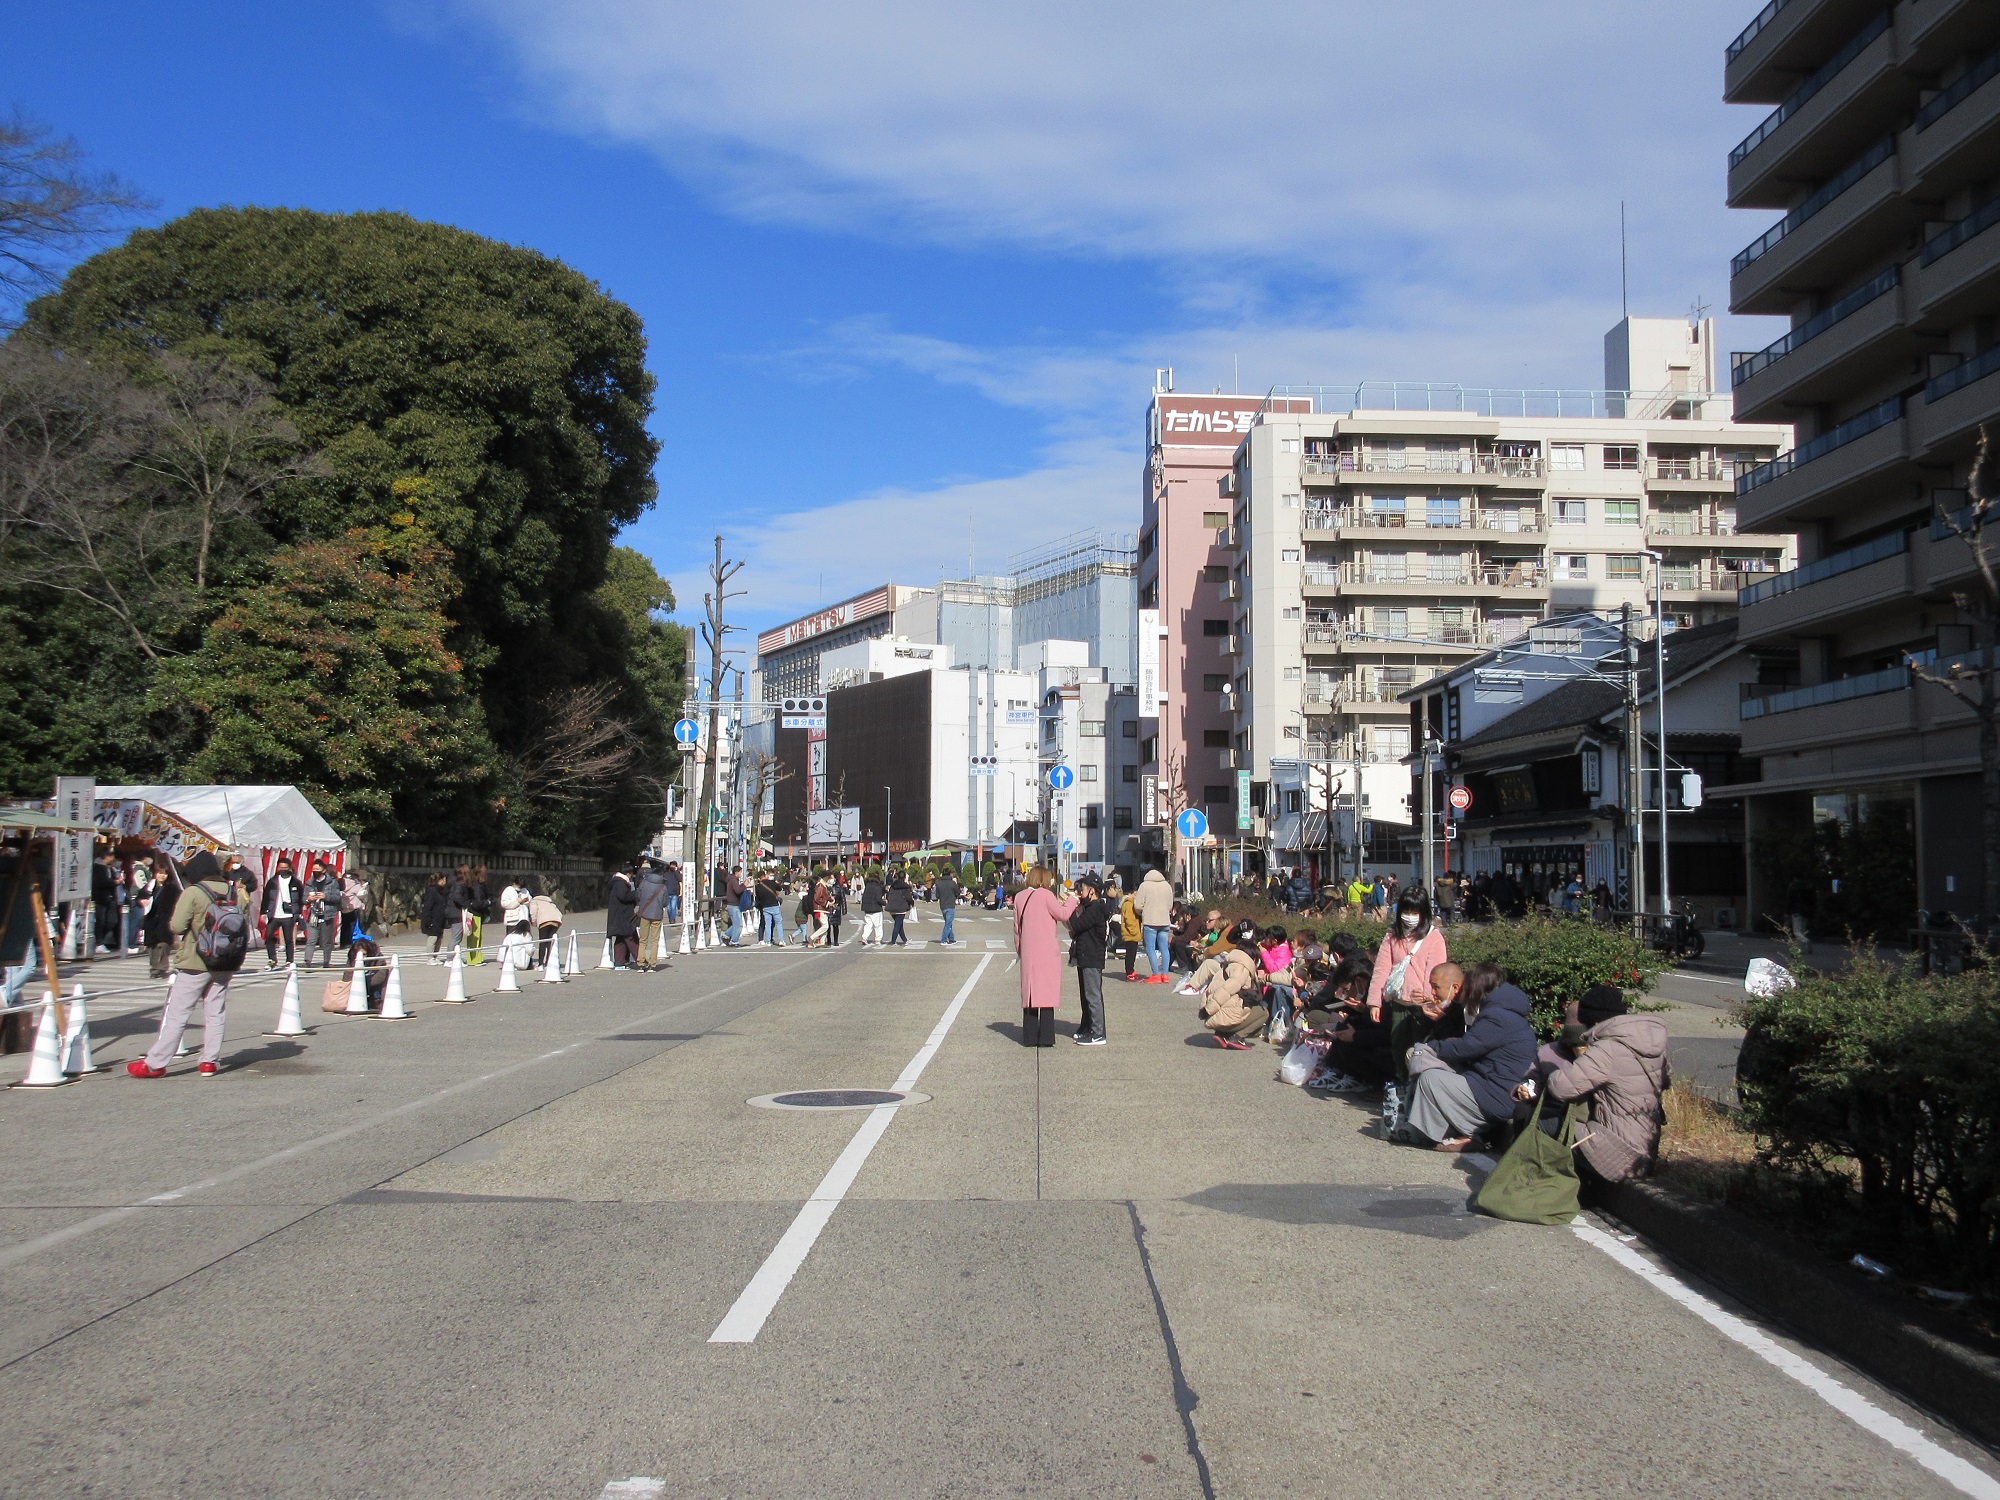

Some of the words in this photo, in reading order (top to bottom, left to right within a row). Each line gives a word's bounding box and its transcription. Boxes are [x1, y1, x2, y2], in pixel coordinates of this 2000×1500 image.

[789, 605, 848, 643] MEITETSU
[784, 718, 824, 726] 歩車分離式
